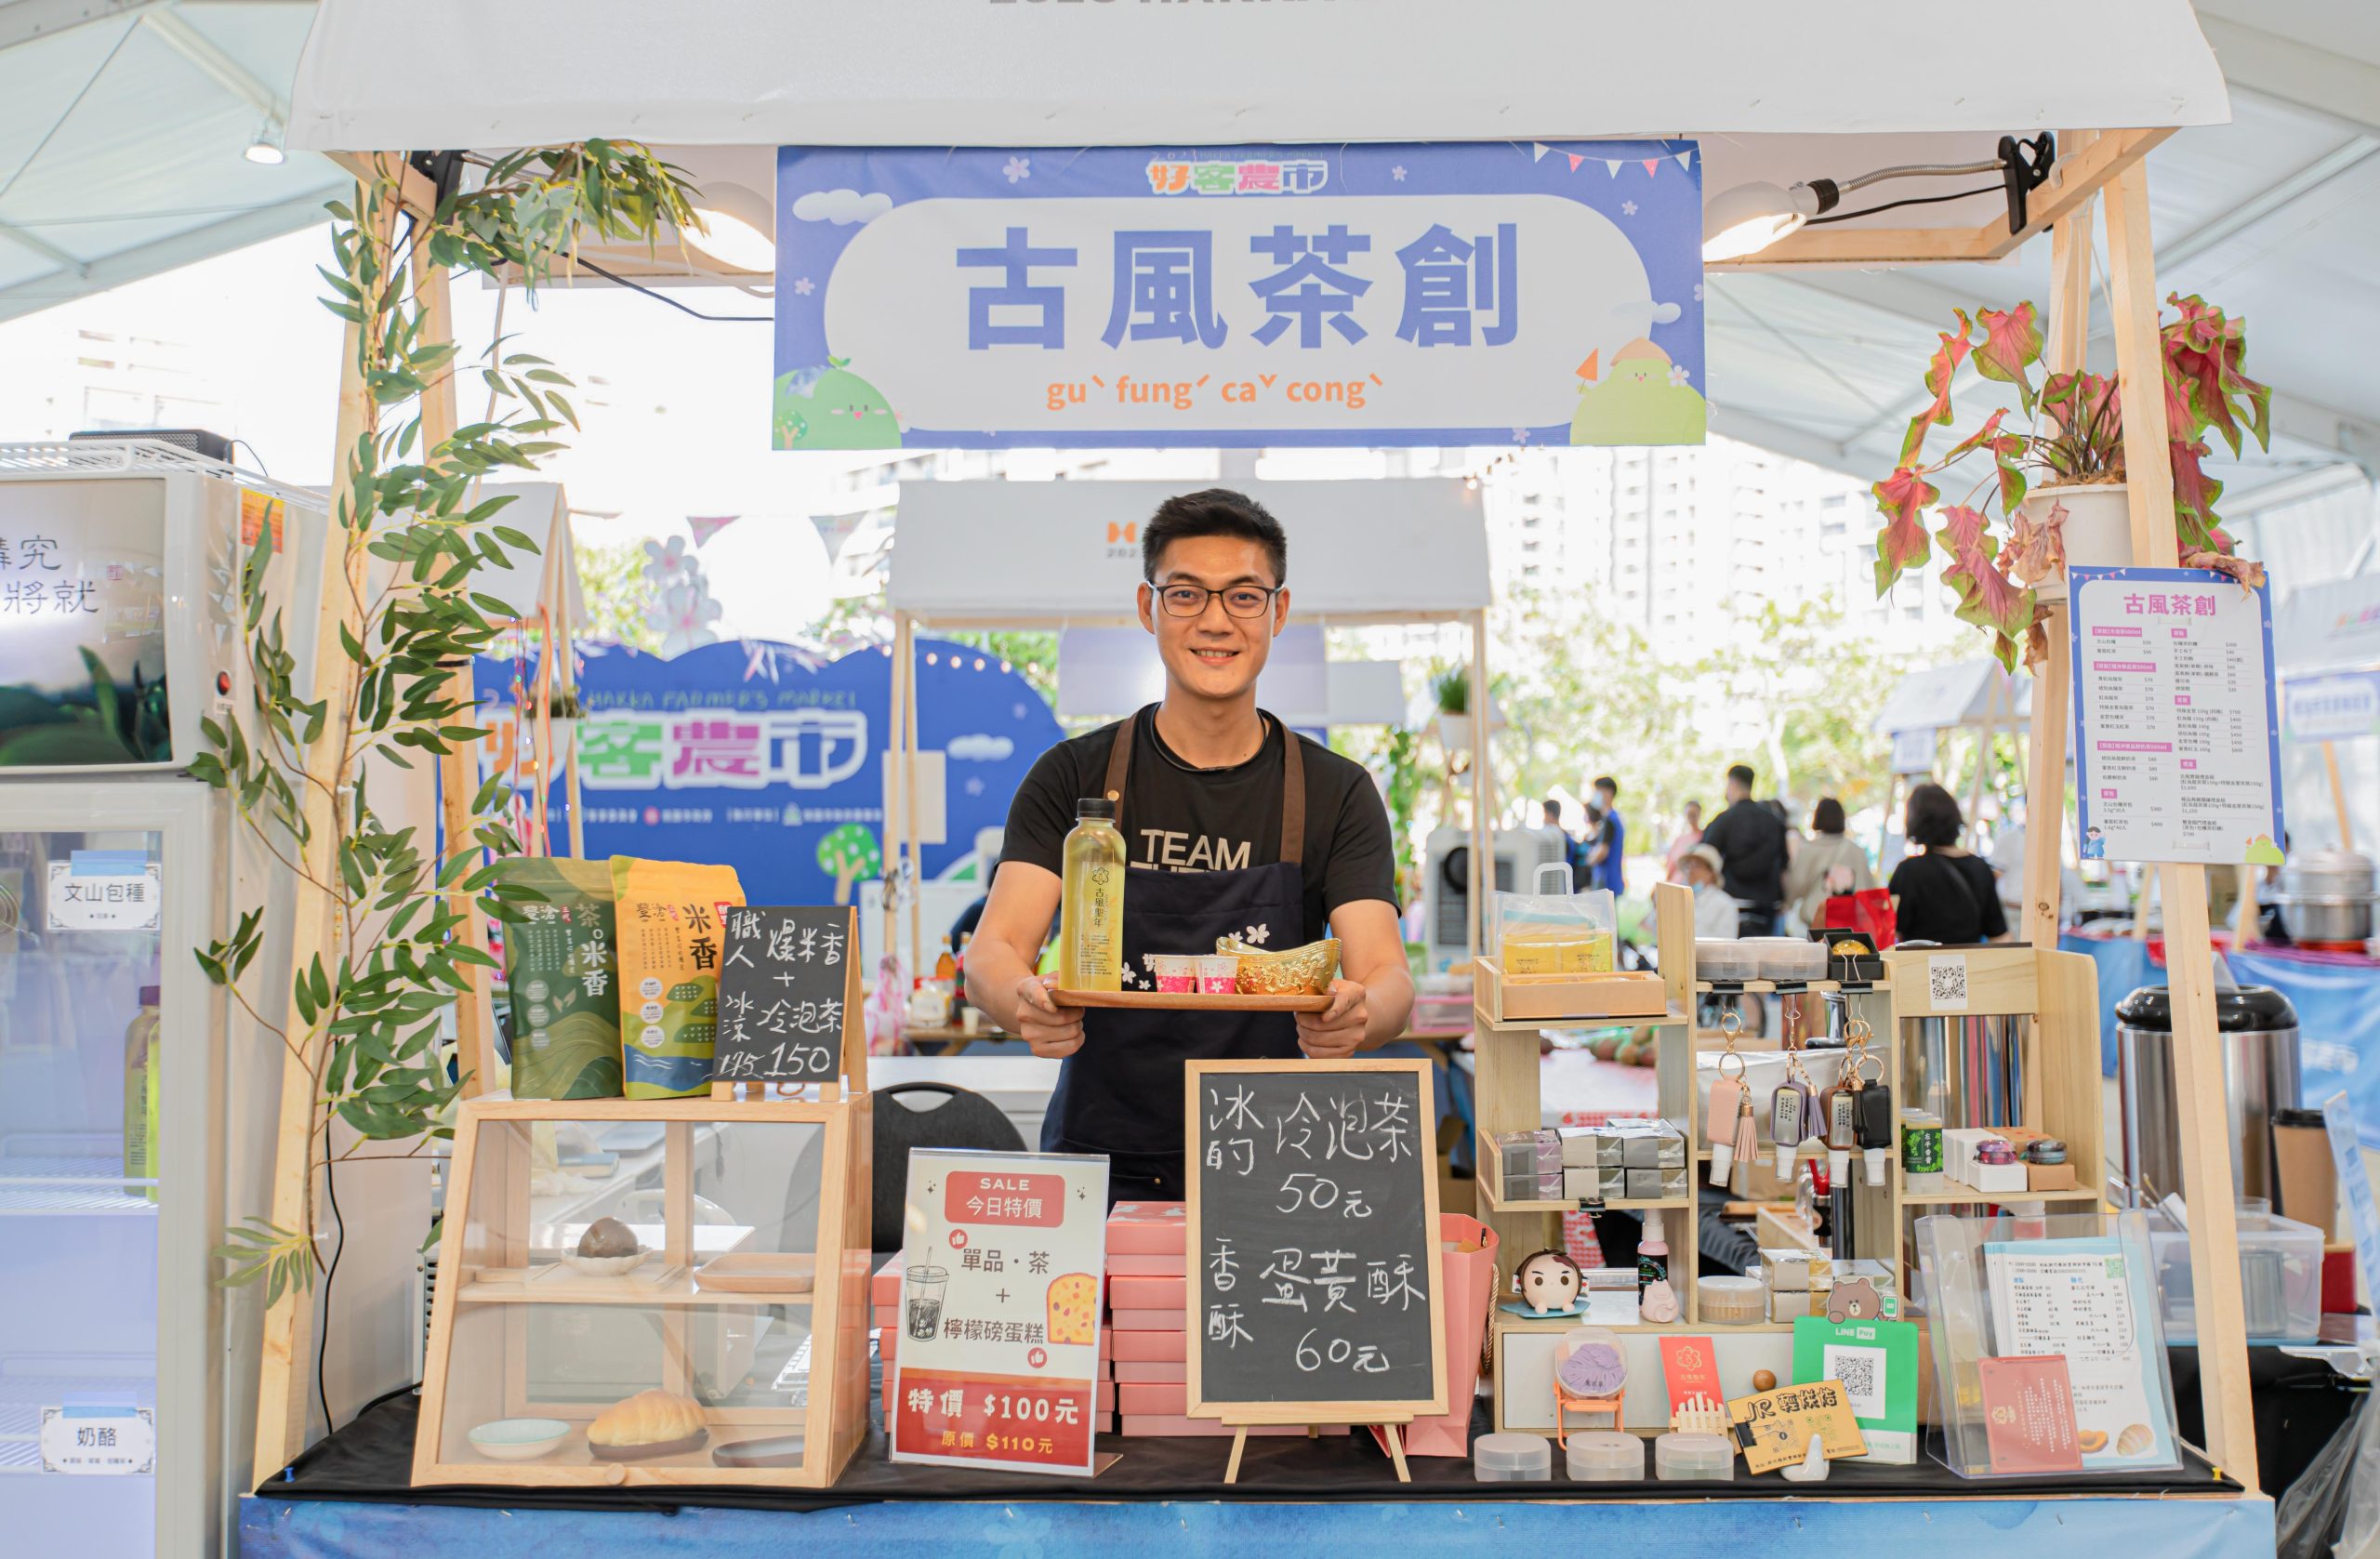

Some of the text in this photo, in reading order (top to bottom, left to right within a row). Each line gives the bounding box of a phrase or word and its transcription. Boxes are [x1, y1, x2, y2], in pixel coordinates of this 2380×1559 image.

[1147, 161, 1328, 194] 好客農市
[956, 223, 1518, 350] 古風茶創
[0, 535, 61, 571] 究
[5, 578, 99, 615] 將就
[2123, 593, 2217, 616] 古風茶創
[1141, 829, 1251, 871] TEAM
[64, 882, 145, 903] 文山包種
[682, 903, 718, 971] 米香
[724, 908, 767, 969] 職人
[765, 918, 846, 967] 爆米香
[757, 997, 844, 1035] 冷泡茶
[762, 1042, 831, 1077] 150
[1207, 1083, 1264, 1175] 冰的
[1276, 1091, 1412, 1163] 冷泡茶
[980, 1177, 1031, 1192] SALE
[1276, 1173, 1373, 1219] 50元
[966, 1195, 1043, 1220] 今日特價
[1208, 1237, 1254, 1349] 香酥
[1260, 1247, 1427, 1313] 蛋黃酥
[944, 1317, 1045, 1345] 檸檬磅蛋糕
[1835, 1328, 1873, 1338] LINE Pay
[1294, 1328, 1392, 1373] 60元
[907, 1389, 1079, 1426] 特價 $100元
[1744, 1386, 1838, 1423] JR 輕烘焙
[76, 1426, 117, 1447] 奶酪
[941, 1430, 1054, 1455] 原價 $110元
